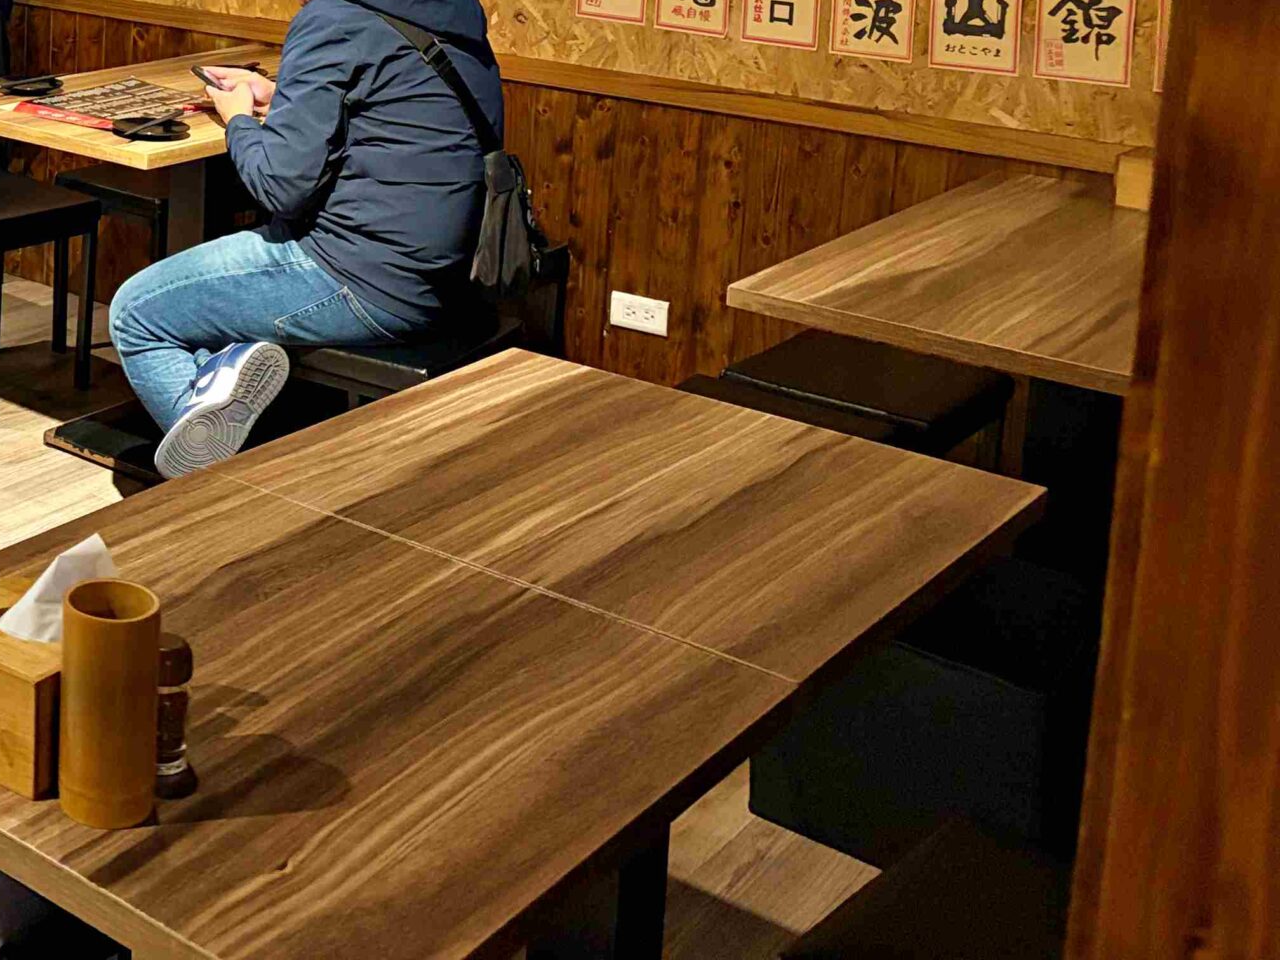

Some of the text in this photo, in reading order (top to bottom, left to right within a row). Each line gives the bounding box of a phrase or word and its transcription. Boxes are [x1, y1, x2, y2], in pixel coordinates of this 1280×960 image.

[944, 42, 1002, 58] おとこやま
